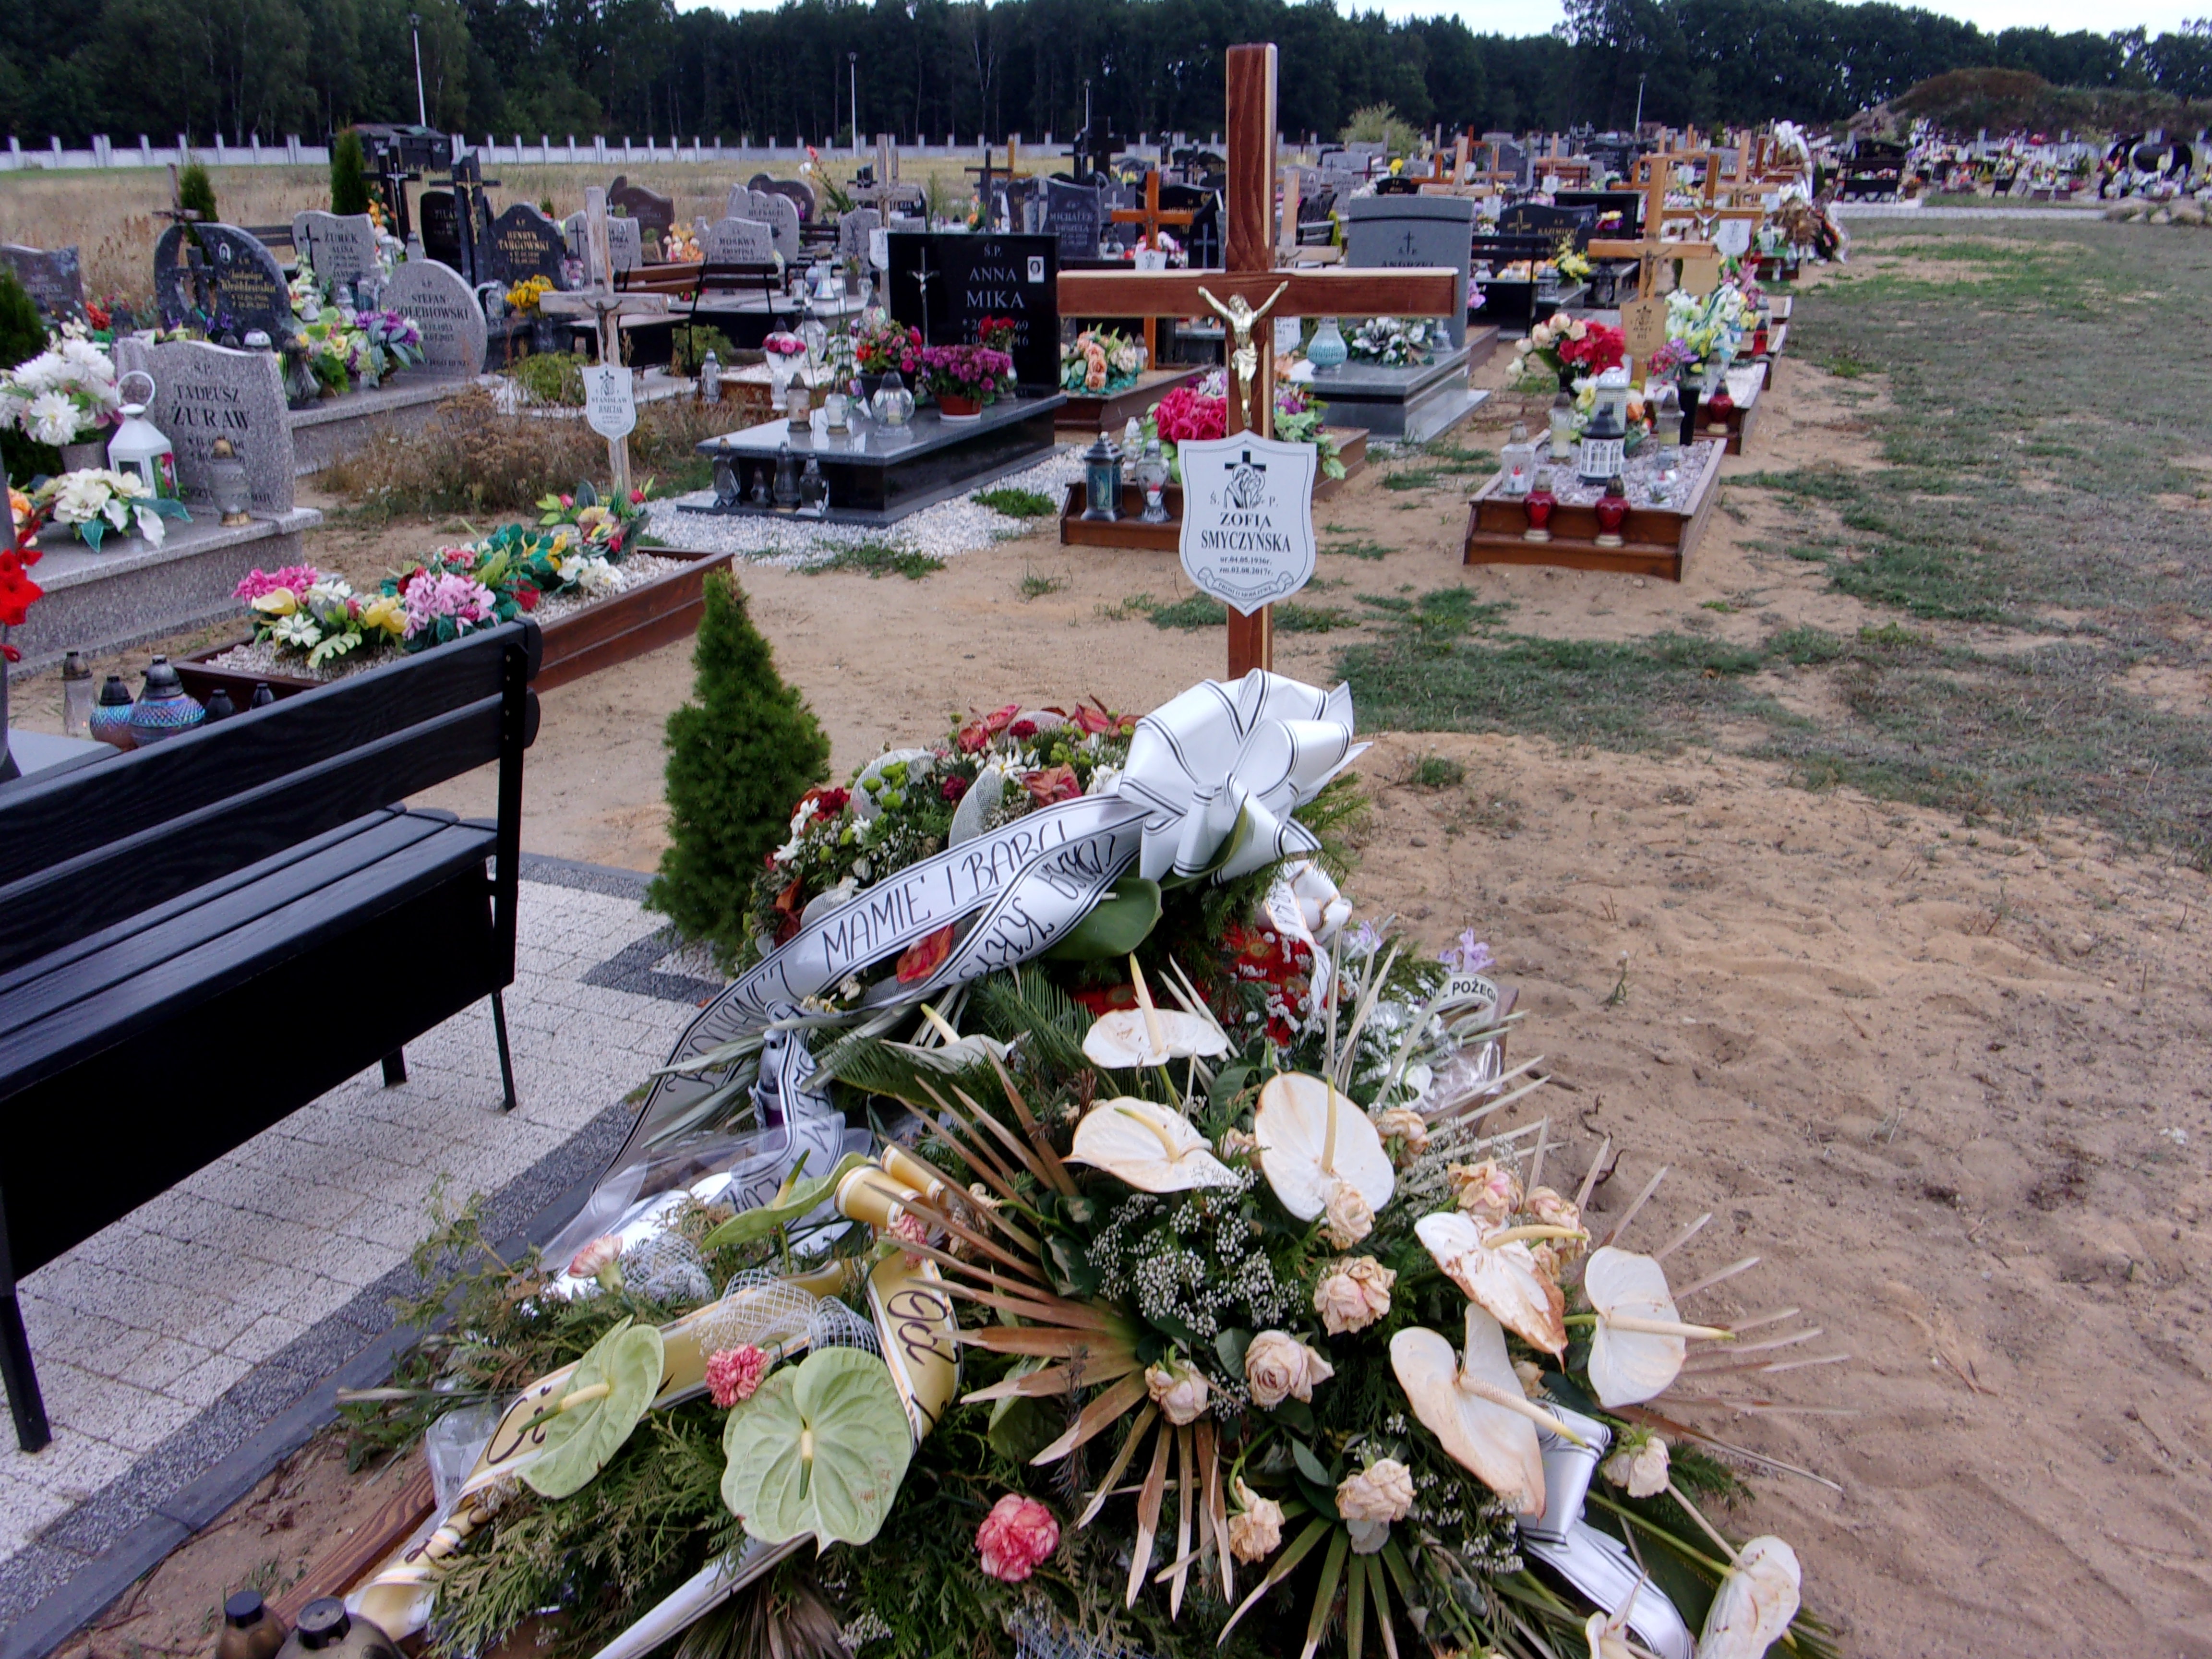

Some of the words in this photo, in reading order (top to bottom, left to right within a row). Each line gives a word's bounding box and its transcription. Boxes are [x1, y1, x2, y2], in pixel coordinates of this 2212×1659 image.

[969, 266, 1017, 282] ANNA
[411, 293, 446, 304] STEFAN
[966, 290, 1026, 309] MIKA
[174, 384, 241, 404] TADEUSZ
[171, 399, 250, 430] ŻURAW
[1220, 511, 1272, 528] ZOFIA
[1201, 527, 1292, 553] SMYCZYŃSKA
[822, 874, 932, 974] MAMIE
